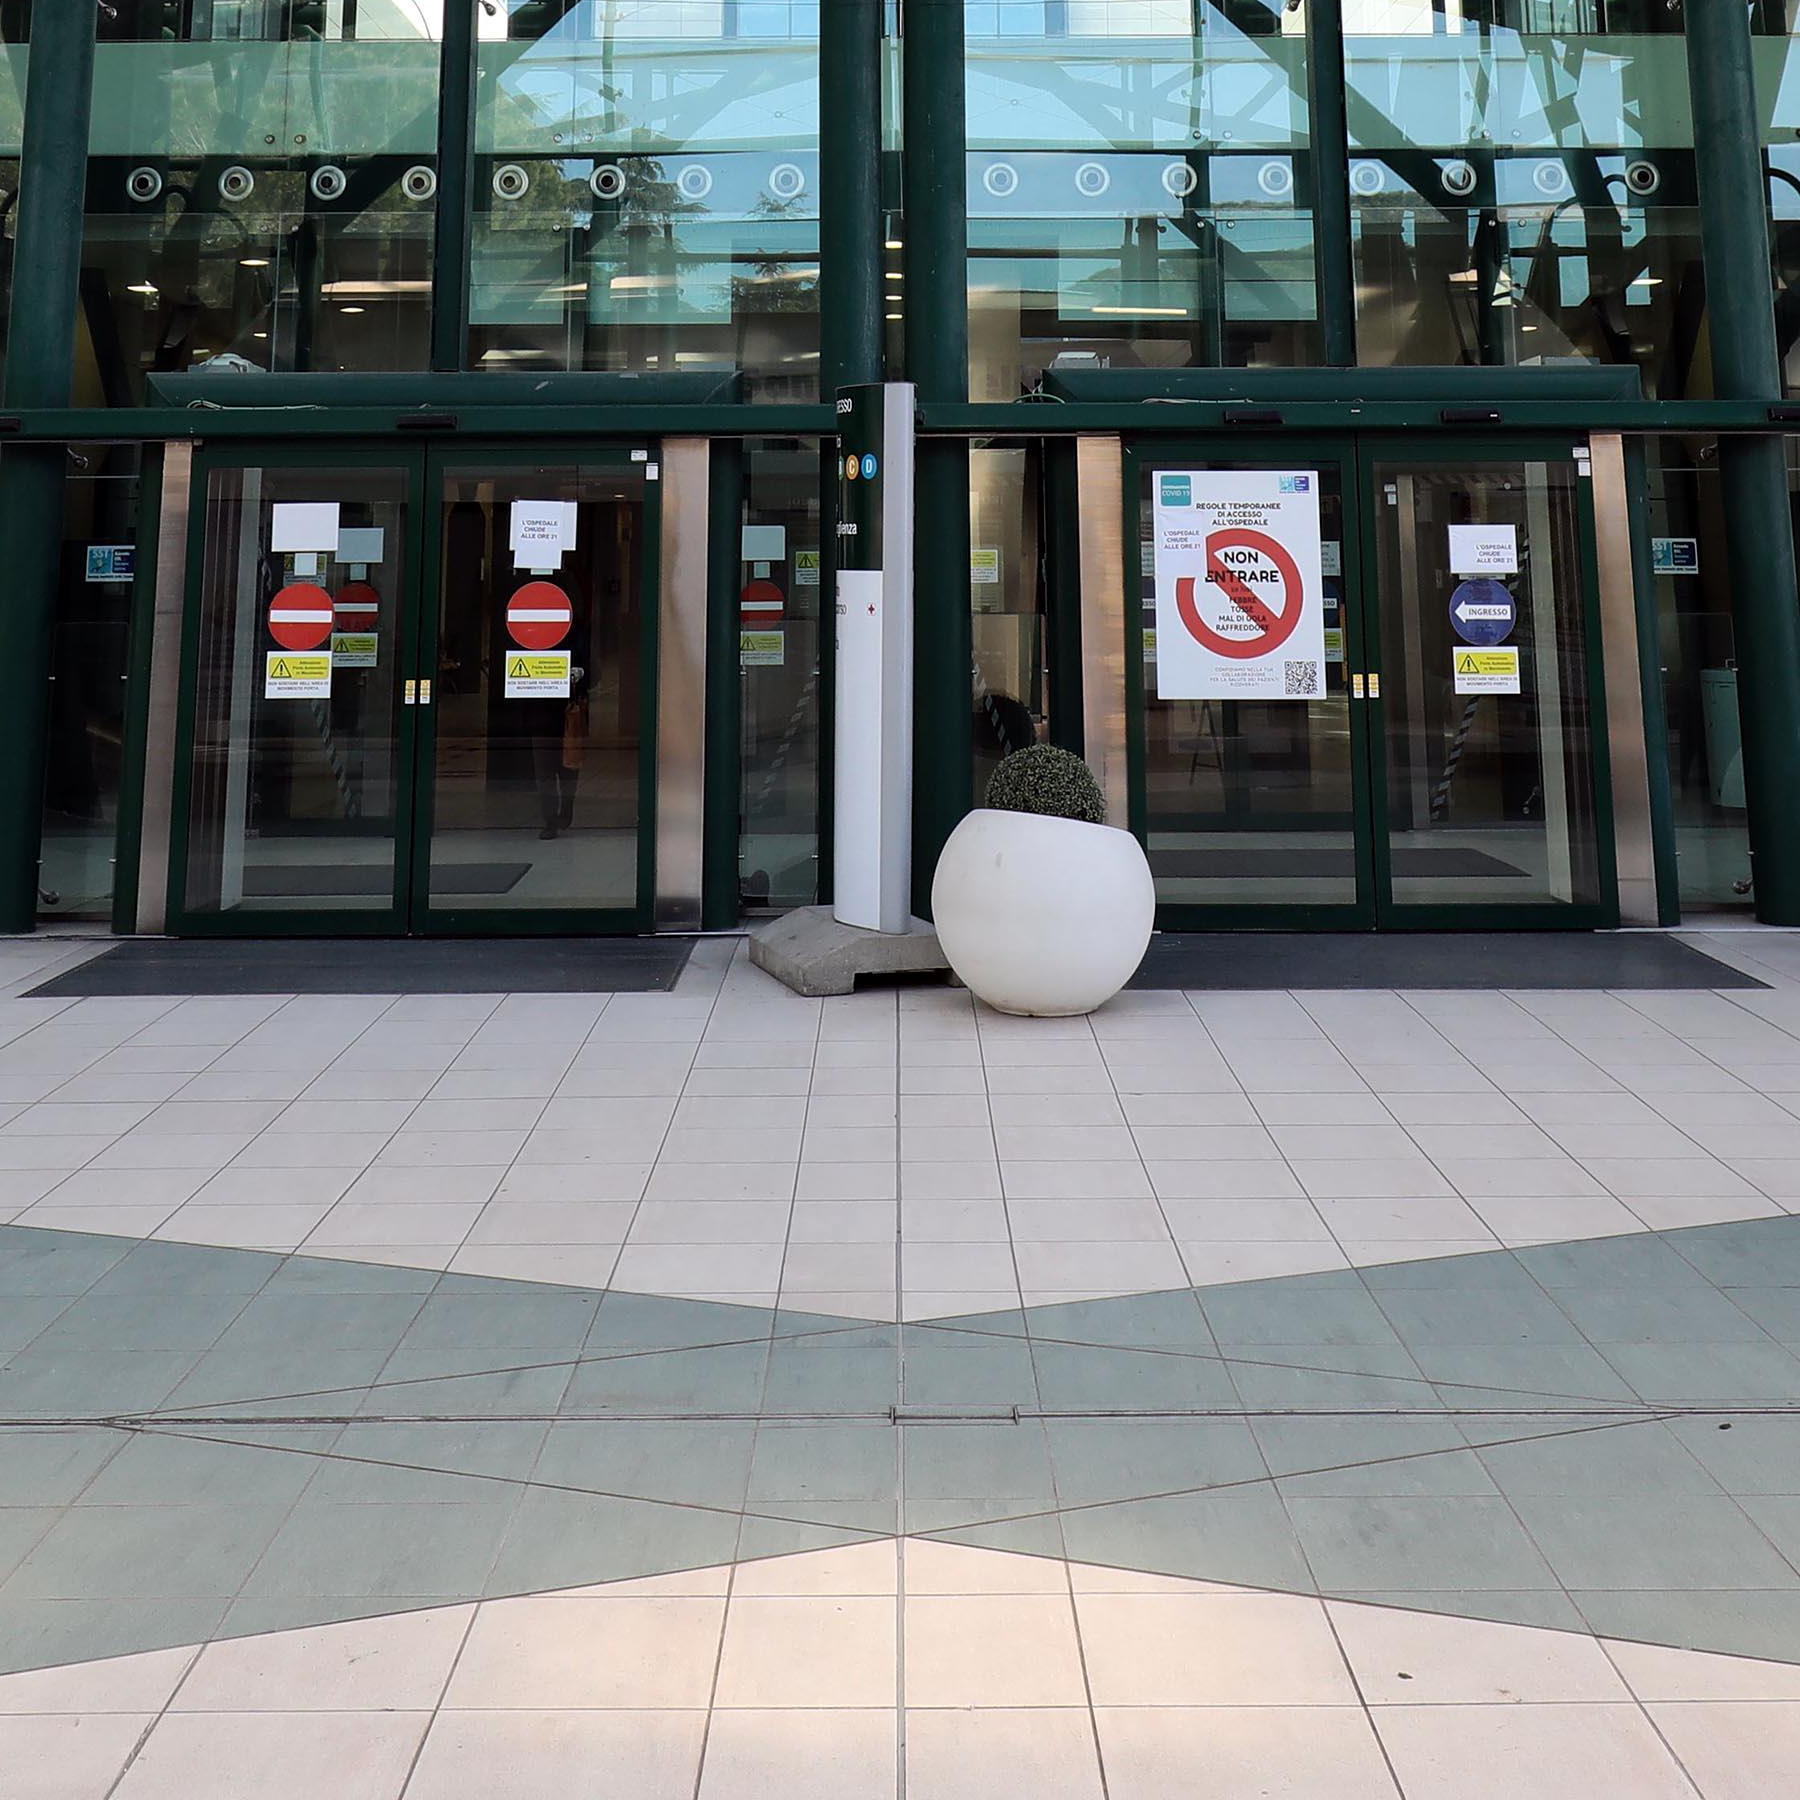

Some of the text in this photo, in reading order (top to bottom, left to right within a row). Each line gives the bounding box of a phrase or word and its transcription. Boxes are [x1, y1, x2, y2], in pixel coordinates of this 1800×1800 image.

[1224, 552, 1259, 564] NON
[1205, 571, 1279, 583] ENTRARE
[1468, 608, 1508, 616] INGRESSO
